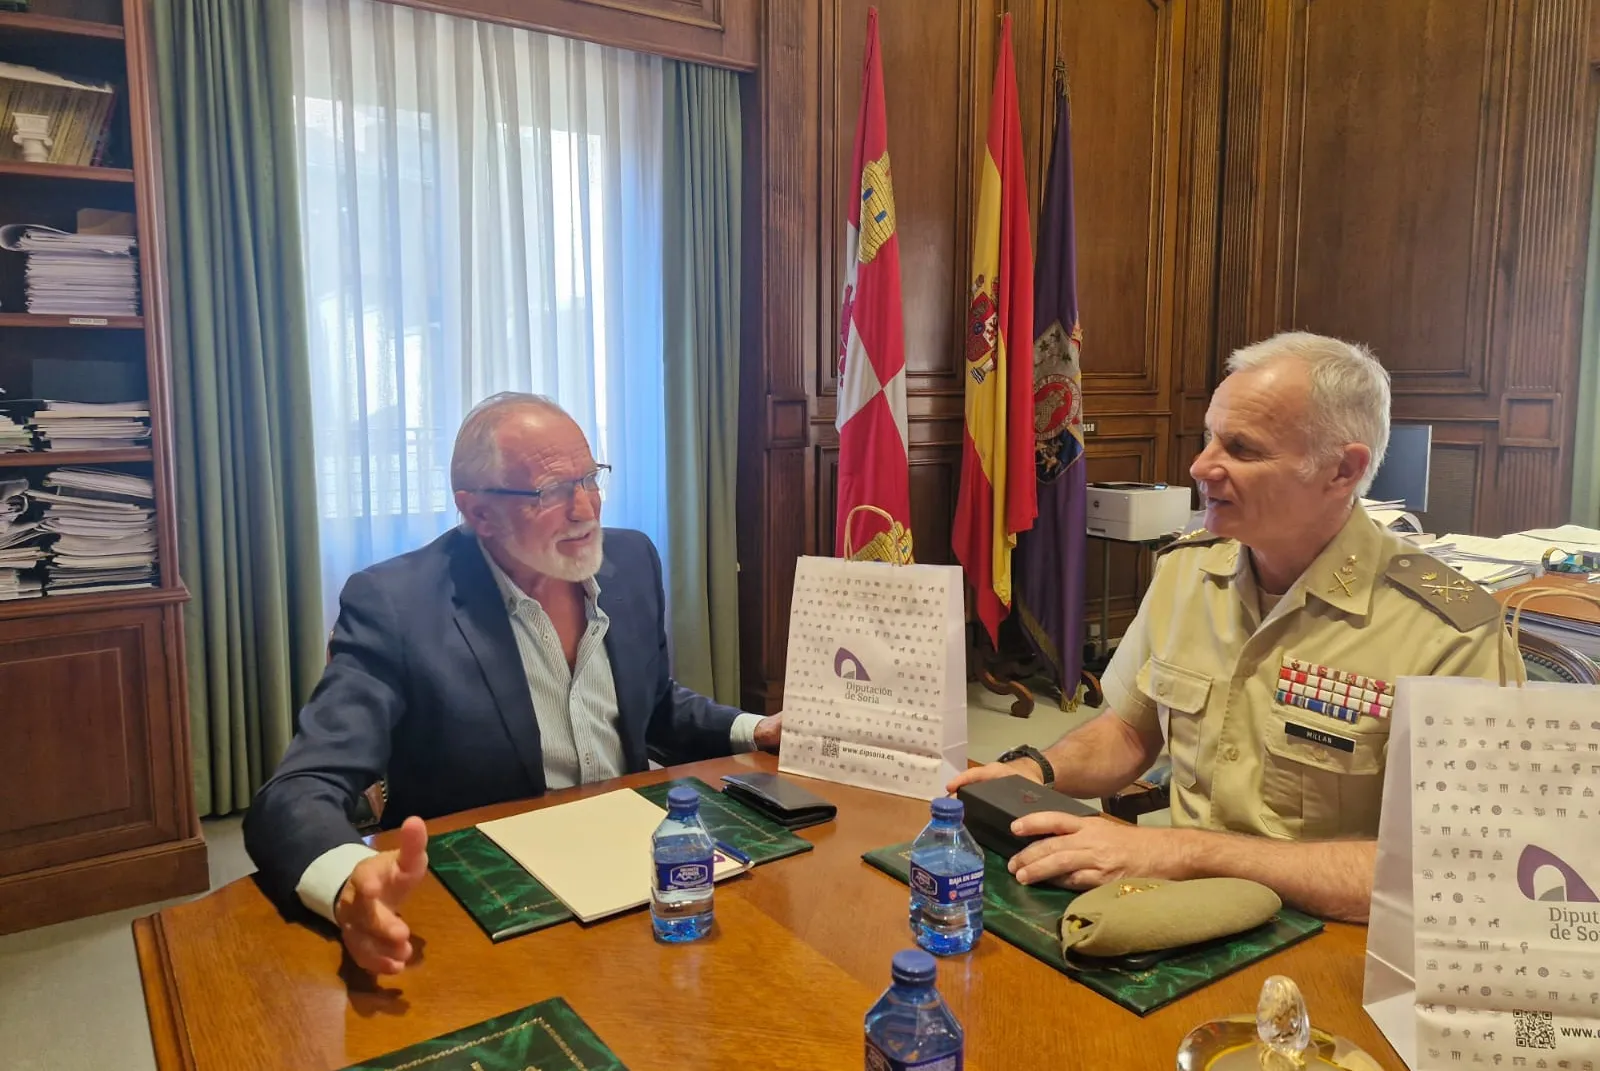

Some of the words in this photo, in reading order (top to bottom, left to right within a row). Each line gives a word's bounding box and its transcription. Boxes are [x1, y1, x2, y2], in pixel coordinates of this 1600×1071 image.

[846, 681, 893, 697] Diputación
[845, 690, 856, 701] de
[857, 692, 880, 704] Soria
[842, 746, 895, 761] www.dipsoria.es
[1550, 923, 1571, 940] de
[1576, 925, 1600, 942] So
